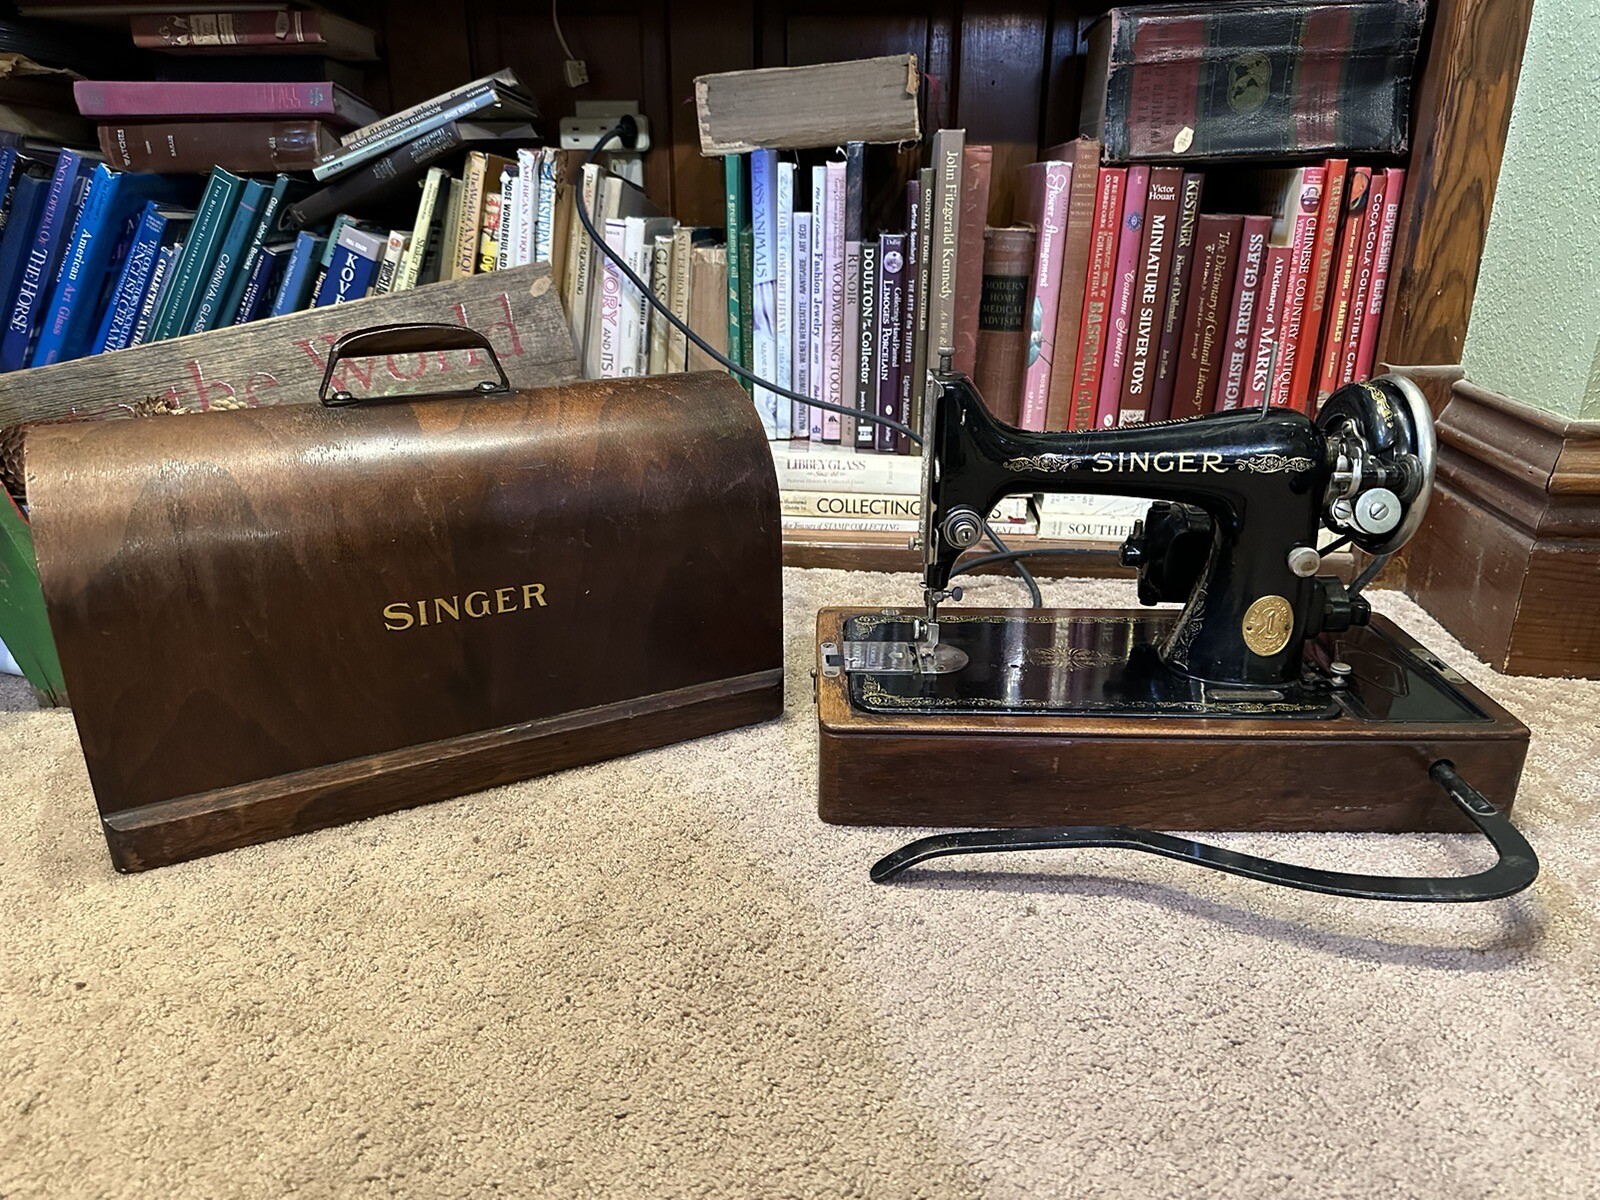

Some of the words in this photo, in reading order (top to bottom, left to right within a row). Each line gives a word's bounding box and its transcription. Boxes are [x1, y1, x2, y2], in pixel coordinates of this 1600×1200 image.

[117, 128, 130, 166] WATCHES
[946, 151, 957, 180] John
[43, 155, 71, 227] ENCYCLOPEDIA
[470, 170, 479, 187] The
[522, 161, 532, 213] AMERICAN
[752, 157, 766, 204] GLASS
[1044, 173, 1066, 218] Flower
[1148, 192, 1175, 200] Houart
[1152, 184, 1174, 193] Victor
[1328, 175, 1342, 222] TREES
[265, 197, 277, 216] Glass
[727, 201, 736, 225] great
[777, 210, 787, 241] LOUIS
[942, 184, 956, 243] Fitzgerald
[1179, 180, 1198, 246] KESTNER
[256, 221, 266, 238] John
[500, 204, 510, 250] WONDERFUL
[728, 226, 736, 253] name
[752, 206, 767, 276] ANIMALS
[798, 240, 806, 252] ART
[1217, 231, 1230, 251] The
[1289, 217, 1305, 265] VERNACULAR
[1298, 215, 1315, 273] CHINESE
[1323, 227, 1333, 245] OF
[1363, 193, 1381, 264] COCA-COLA
[1375, 202, 1396, 272] DEPRESSION
[25, 249, 47, 280] THE
[69, 229, 90, 279] American
[144, 240, 156, 256] THE
[186, 232, 203, 272] ILLUSTRATED
[243, 247, 257, 269] Brooks
[413, 238, 427, 266] Shaker
[499, 252, 507, 267] OLD
[673, 233, 685, 296] PORCELAIN
[729, 253, 737, 264] in
[1038, 217, 1057, 286] Arrangement
[1090, 234, 1105, 297] COLLECTIBLE
[1143, 215, 1164, 302] MINIATURE
[1173, 254, 1184, 274] King
[1244, 234, 1262, 286] GLASS
[1275, 256, 1283, 266] A
[122, 242, 149, 298] ENGLISH
[142, 259, 165, 316] COLLECTING
[206, 254, 229, 300] CARNIVAL
[313, 271, 326, 297] Repair
[576, 247, 586, 294] RUGMAKING
[652, 248, 669, 301] GLASS
[729, 264, 738, 279] oil
[777, 245, 786, 294] COMFORT
[814, 251, 824, 293] Fashion
[847, 253, 859, 304] RENOIR
[862, 249, 873, 316] DOULTON
[985, 281, 1025, 291] MODERN
[1173, 276, 1181, 286] of
[1207, 255, 1225, 309] Dictionary
[1266, 265, 1282, 311] Dictionary
[1283, 267, 1297, 304] FURNITURE
[1313, 249, 1330, 310] AMERICA
[1342, 269, 1350, 288] BOOK
[10, 280, 37, 332] HORSE
[62, 283, 75, 301] Art
[831, 261, 843, 360] WOODWORKING
[880, 280, 893, 324] LIMOGES
[891, 287, 901, 321] Collecting
[919, 269, 927, 330] COLLECTIBLES
[983, 305, 1023, 315] MEDICAL
[990, 293, 1018, 303] HOME
[1120, 270, 1133, 314] Costume
[1166, 288, 1179, 332] Dollmakers
[1236, 291, 1253, 333] IRISH
[1288, 278, 1305, 338] COUNTRY
[1349, 269, 1369, 347] COLLECTIBLE
[1369, 276, 1384, 315] GLASS
[53, 306, 69, 334] Glass
[194, 303, 210, 335] GLASS
[776, 295, 785, 336] TIFFANY
[810, 296, 823, 337] Jewelry
[891, 322, 899, 344] Hand
[940, 310, 947, 319] As
[940, 322, 947, 337] We
[983, 315, 1022, 325] ADVISER
[1135, 308, 1152, 355] SILVER
[1204, 311, 1217, 324] of
[1266, 313, 1274, 323] of
[1281, 306, 1290, 322] AND
[1334, 300, 1346, 341] MARBLES
[294, 292, 525, 393] World
[601, 327, 610, 350] AND
[798, 340, 806, 363] WIENER
[861, 331, 871, 382] Collector
[879, 328, 891, 380] PORCELAIN
[891, 343, 899, 367] Painted
[1079, 300, 1104, 386] BASEBALL
[1113, 318, 1126, 366] Jewelers
[1201, 325, 1215, 365] Cultural
[1234, 337, 1246, 349] &
[1273, 324, 1288, 367] ACCESSORIES
[600, 352, 613, 370] ITS
[1130, 359, 1145, 393] TOYS
[1252, 328, 1274, 390] MARKS
[1273, 342, 1294, 403] ANTIQUES
[1343, 352, 1355, 382] CARS
[827, 364, 840, 404] TOOLS
[901, 396, 909, 425] Publishing
[1025, 391, 1033, 423] SPARNON
[787, 459, 826, 470] LIBBEY
[828, 460, 866, 471] GLASS
[1092, 451, 1229, 474] SINGER
[822, 522, 850, 531] STAMP
[849, 521, 901, 533] COLLECTING
[383, 583, 549, 631] SINGER
